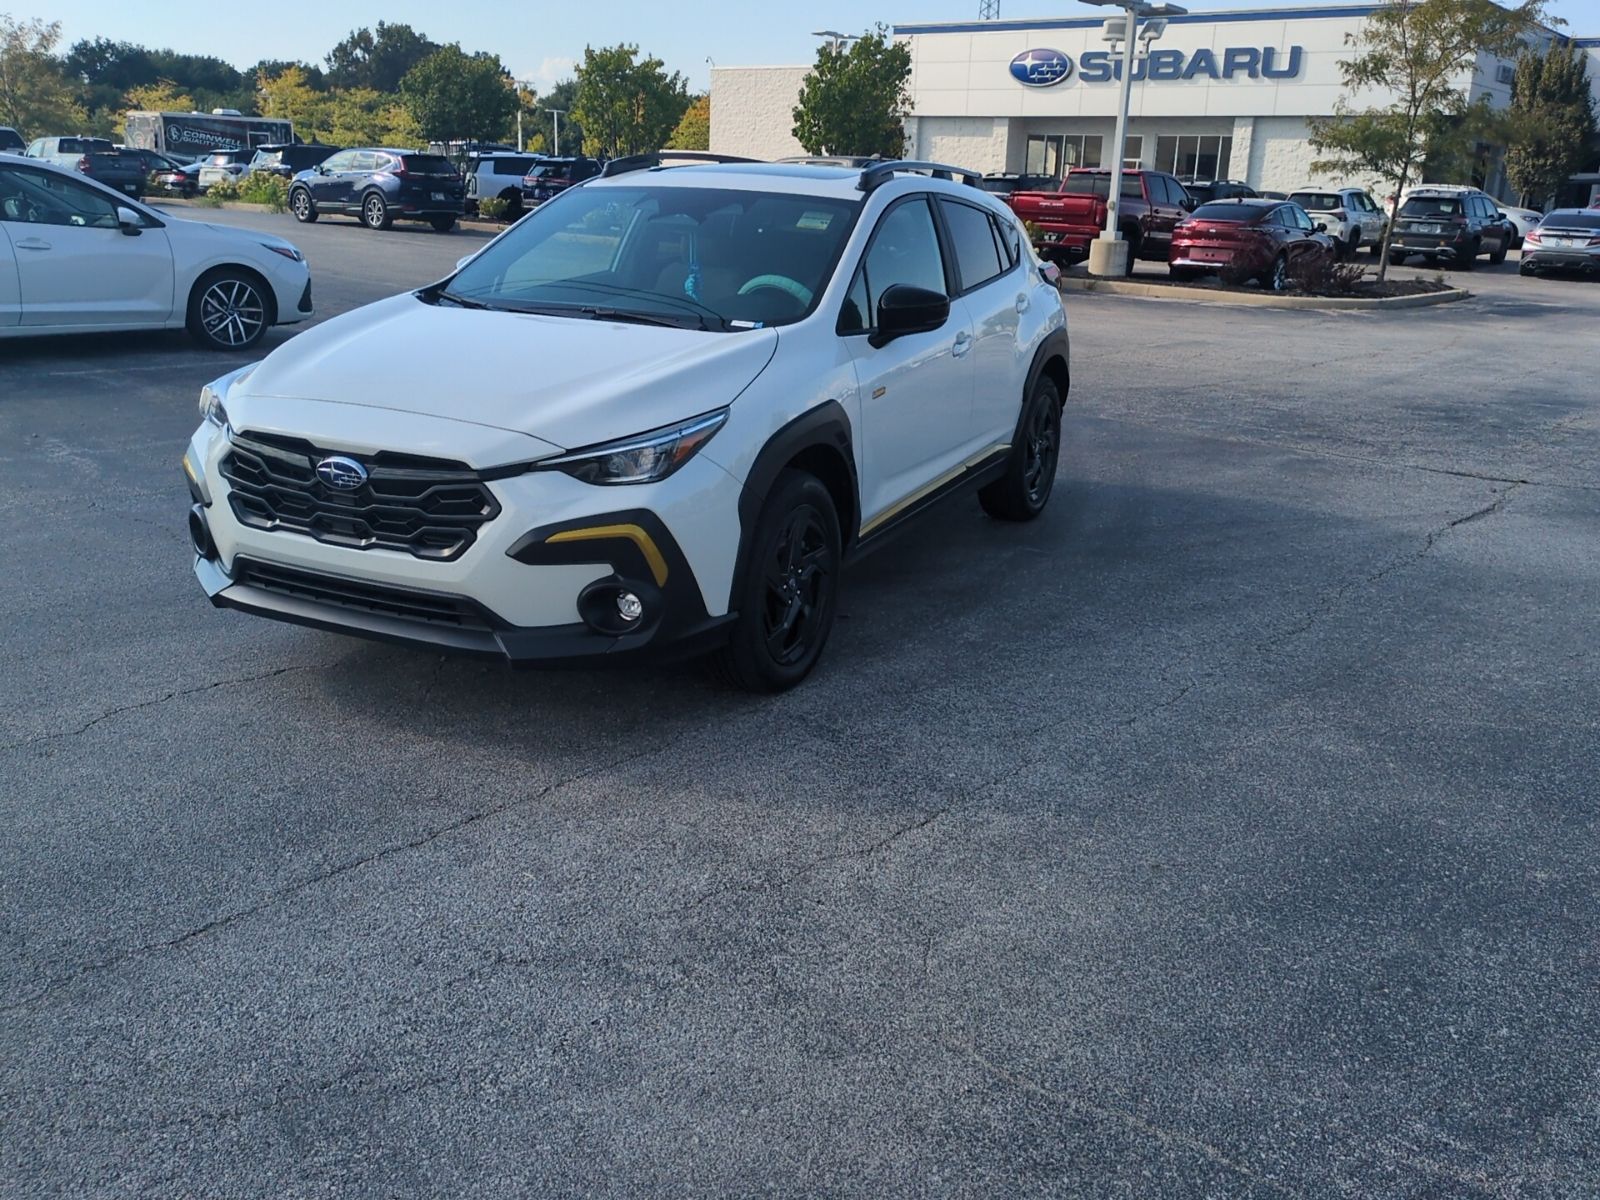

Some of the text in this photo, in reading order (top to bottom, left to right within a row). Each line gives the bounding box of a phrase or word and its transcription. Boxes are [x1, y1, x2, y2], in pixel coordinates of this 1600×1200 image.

[1079, 46, 1302, 82] SUBARU
[183, 130, 241, 146] CORNWELL
[183, 136, 215, 146] QUALITY
